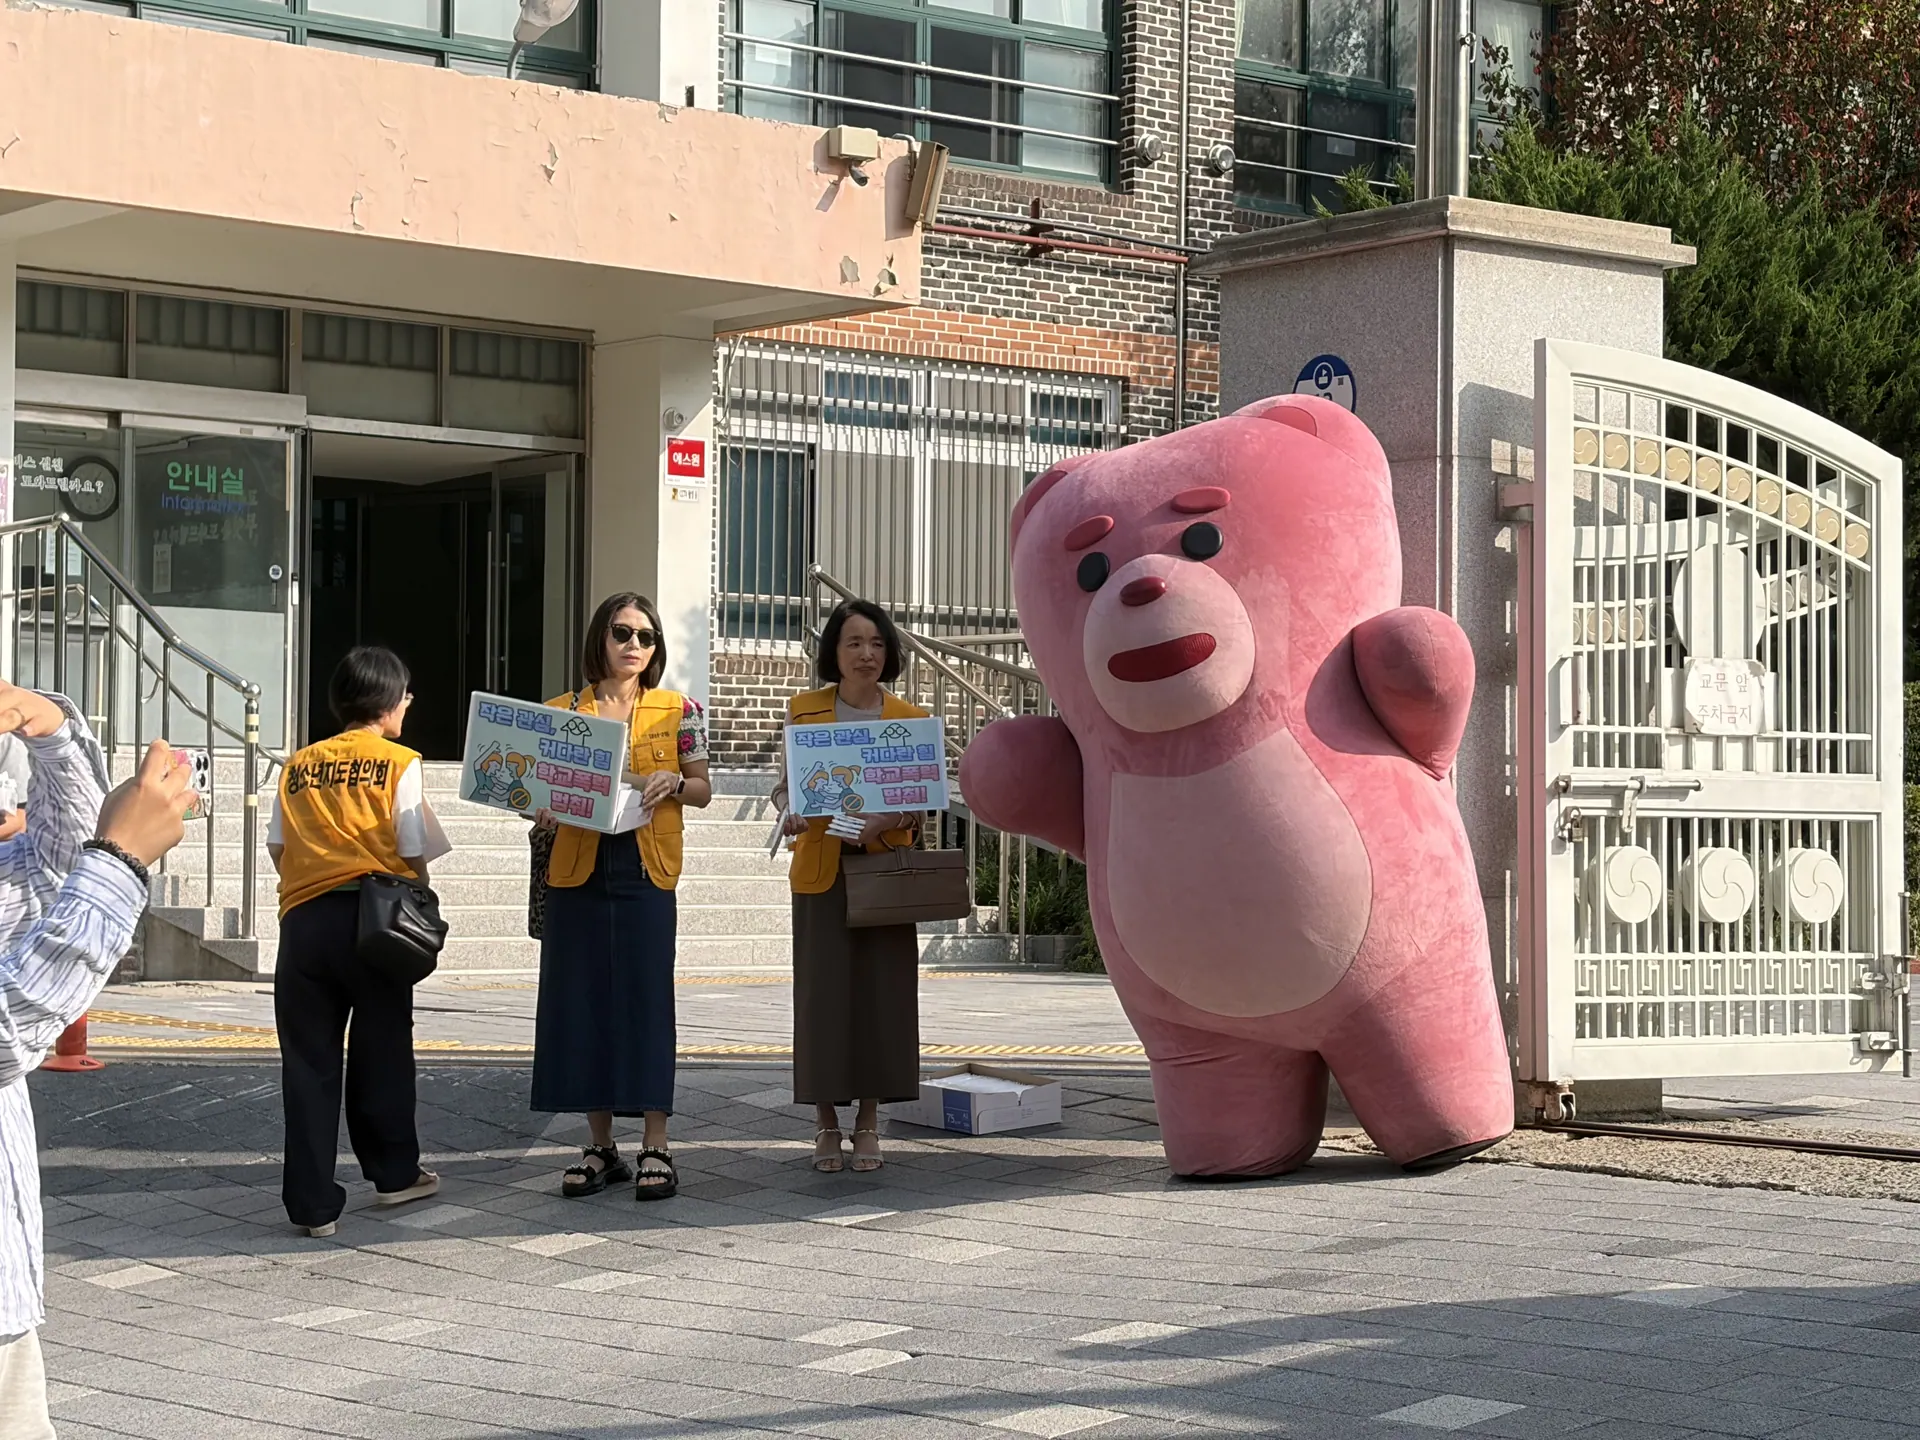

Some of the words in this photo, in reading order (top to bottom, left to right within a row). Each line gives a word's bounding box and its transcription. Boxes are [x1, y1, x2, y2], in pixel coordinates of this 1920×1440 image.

[166, 461, 244, 496] 안내실
[161, 491, 250, 516] Information
[1700, 673, 1728, 692] 교문
[1736, 673, 1750, 693] 앞
[478, 701, 514, 726] 작은
[516, 708, 557, 736] 관심,
[1697, 704, 1752, 725] 주차금지
[795, 730, 832, 748] 작은
[833, 728, 876, 746] 관심,
[538, 737, 592, 764] 커다란
[592, 748, 613, 771] 힘
[861, 744, 915, 764] 커다란
[916, 743, 936, 761] 힘
[287, 758, 391, 795] 청소년지도협의회
[536, 761, 612, 797] 학교폭력
[863, 763, 940, 785] 학교폭력
[550, 789, 595, 820] 멈춰!
[881, 785, 928, 806] 멈춰!
[946, 1112, 955, 1124] 75
